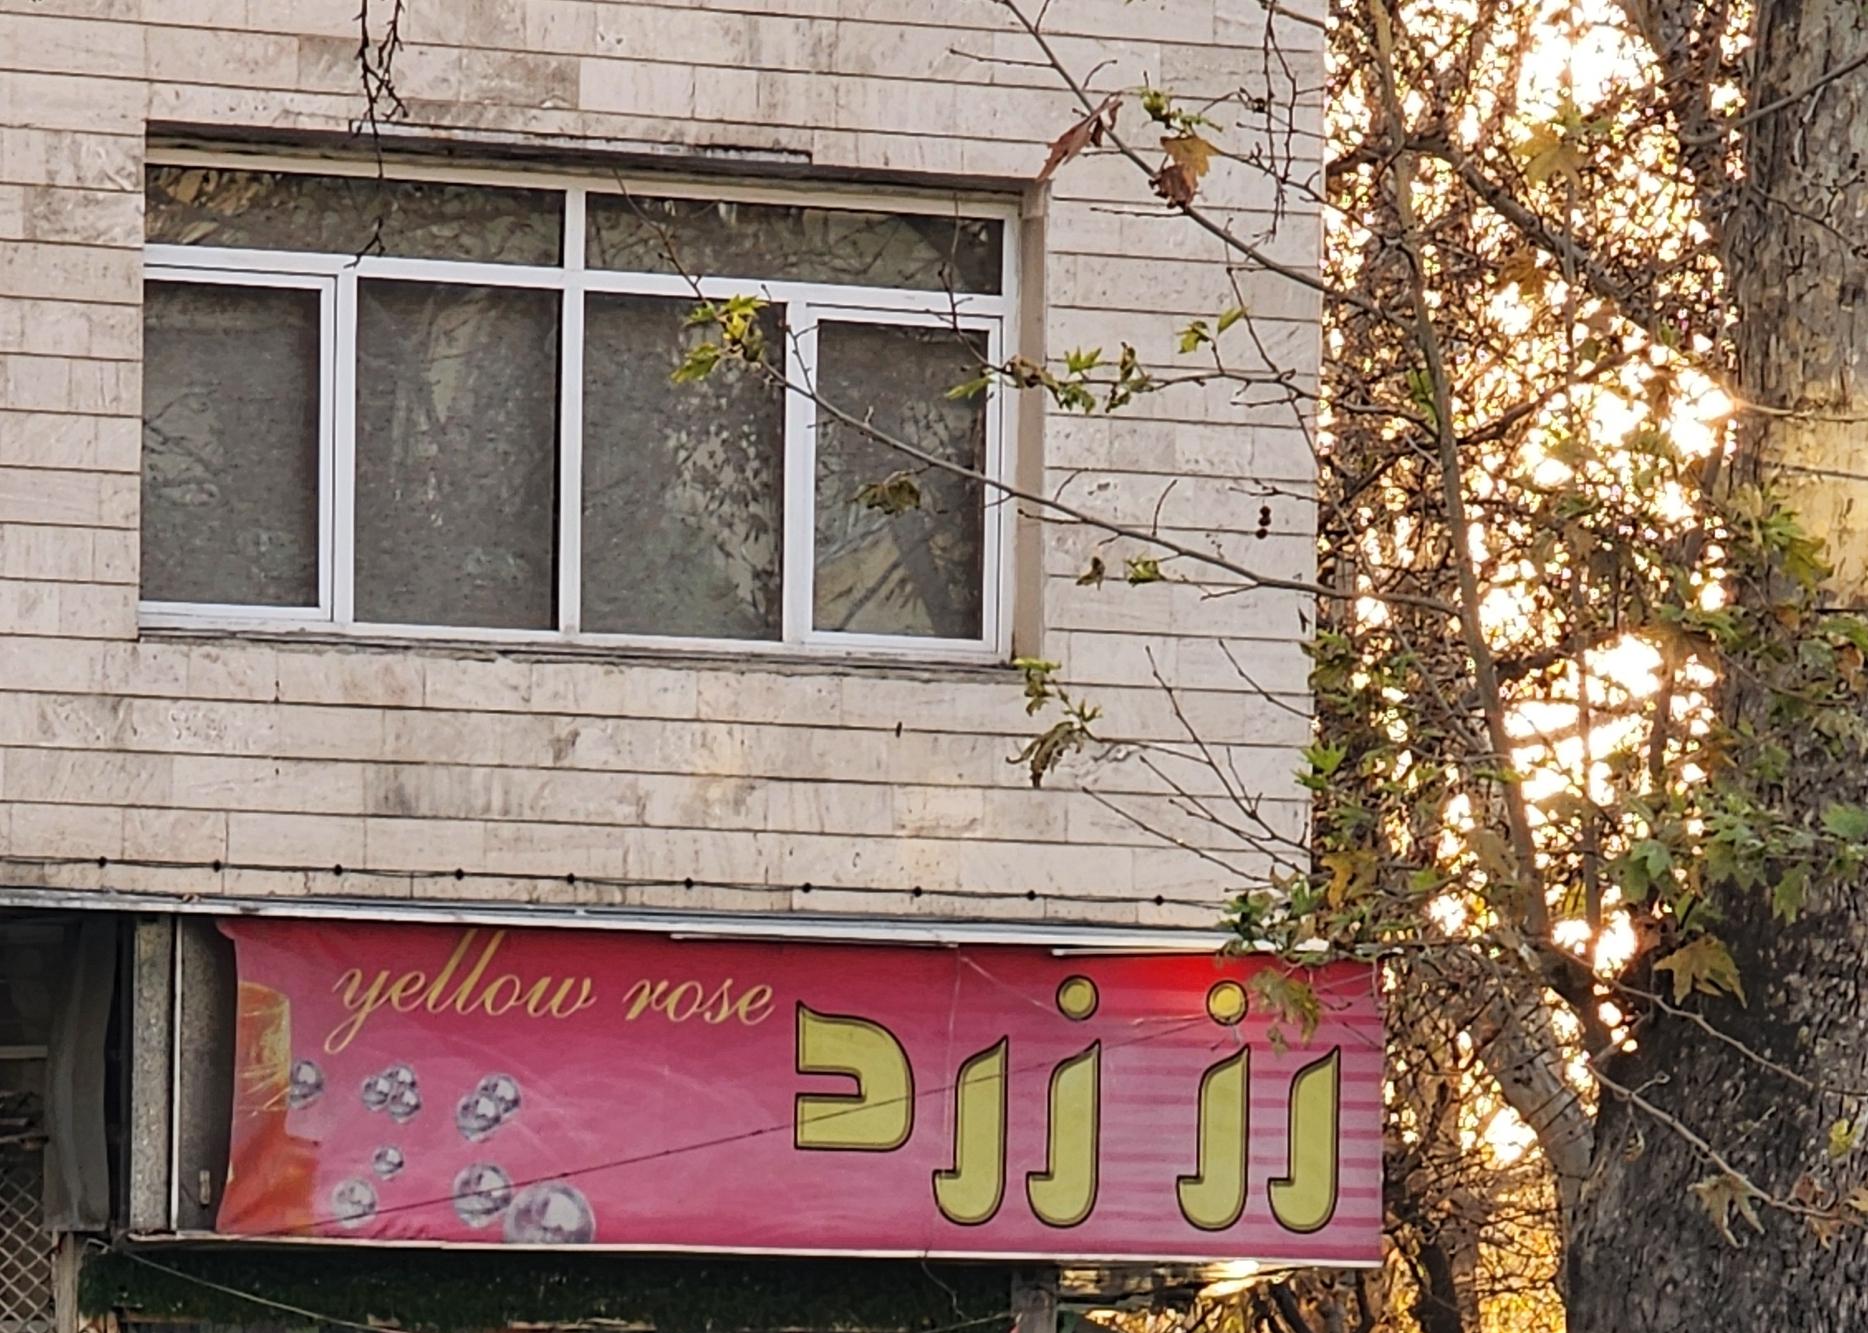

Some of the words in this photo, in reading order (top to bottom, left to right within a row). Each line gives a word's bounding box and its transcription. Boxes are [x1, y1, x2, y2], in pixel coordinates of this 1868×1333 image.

[325, 929, 597, 1054] yellow
[623, 977, 773, 1026] rose
[795, 976, 1102, 1227] زرد
[1177, 979, 1341, 1234] رز
